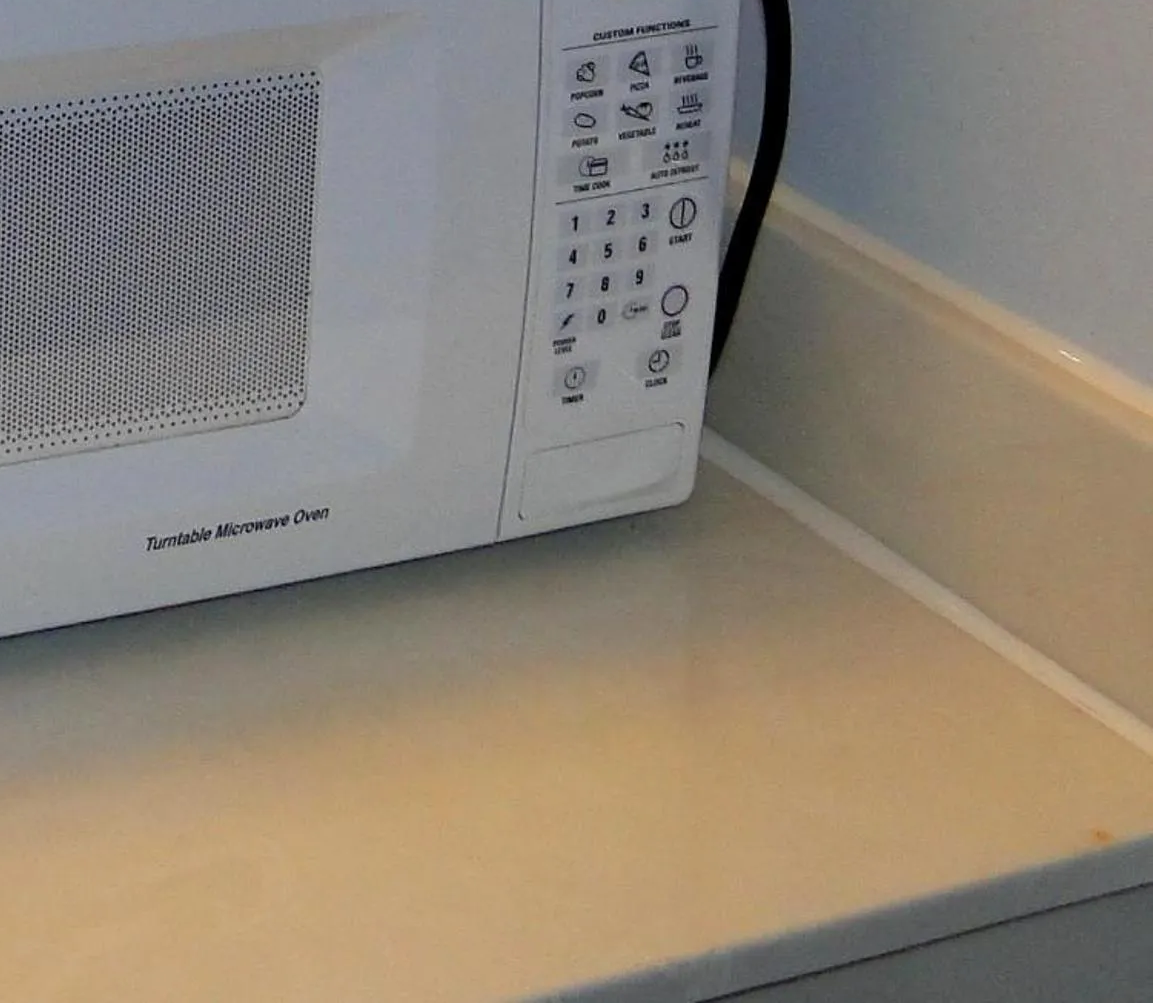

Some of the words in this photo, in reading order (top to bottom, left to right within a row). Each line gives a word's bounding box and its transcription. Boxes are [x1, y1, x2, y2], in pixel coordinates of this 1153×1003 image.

[592, 26, 635, 42] CUSTOM
[636, 18, 691, 36] FUNCTIONS
[673, 72, 709, 85] BEVERAGE
[570, 88, 605, 101] POPCORN
[571, 136, 599, 148] POTATO
[618, 127, 657, 141] VEGETABLE
[651, 168, 669, 180] AUTO
[606, 209, 617, 226] 2
[641, 203, 651, 219] 3
[571, 215, 580, 233] 1
[638, 236, 648, 252] 6
[669, 232, 694, 246] START
[568, 249, 578, 265] 4
[603, 243, 613, 259] 5
[600, 276, 610, 292] 8
[635, 269, 644, 285] 9
[566, 282, 575, 299] 7
[597, 308, 607, 324] 0
[145, 528, 213, 551] Turntable
[214, 514, 291, 540] Microwave
[293, 507, 330, 524] Oven
